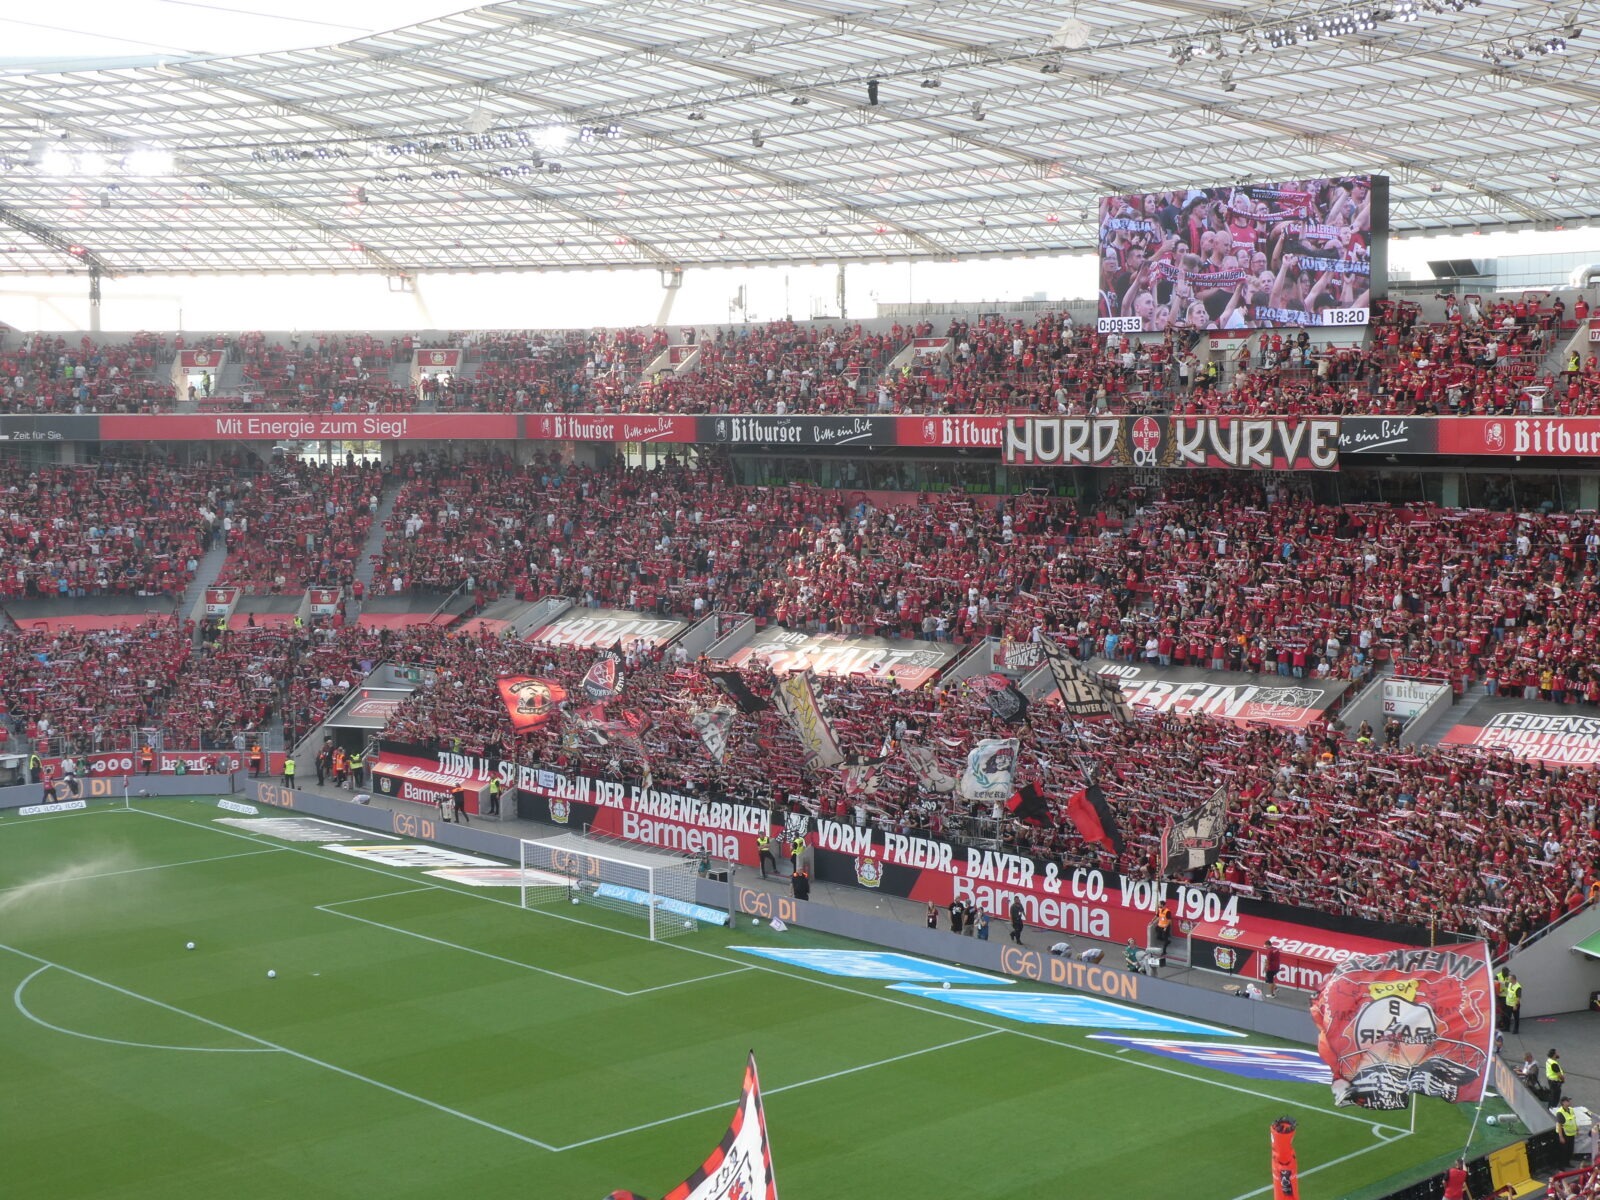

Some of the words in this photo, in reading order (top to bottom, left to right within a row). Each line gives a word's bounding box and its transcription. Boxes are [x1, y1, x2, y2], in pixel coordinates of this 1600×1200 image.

[1099, 319, 1141, 331] 0:09:53
[1329, 310, 1365, 323] 18:20
[13, 431, 30, 440] Zeit
[33, 431, 46, 440] für
[47, 431, 64, 440] Sie.
[216, 418, 243, 434] Mit
[248, 418, 315, 438] Energie
[320, 421, 357, 434] zum
[363, 418, 407, 438] Sieg!
[554, 416, 615, 439] Bitburger
[624, 424, 642, 440] Bitte
[644, 426, 658, 435] ein
[658, 417, 674, 431] Bit
[731, 417, 802, 442] Bitburger
[813, 425, 835, 443] Bitte
[837, 428, 853, 438] ein
[854, 418, 873, 434] Bit
[941, 418, 1002, 446] Bitbur
[1133, 430, 1159, 438] BAYER
[1355, 428, 1380, 443] ein
[1382, 420, 1409, 440] Bit
[1176, 419, 1340, 468] KURVE
[1133, 447, 1158, 467] 04
[772, 632, 809, 645] FÜR
[1097, 664, 1141, 679] UND
[1384, 702, 1395, 712] D2
[281, 789, 293, 808] DI
[421, 821, 435, 840] DI
[438, 751, 474, 779] TURN
[479, 757, 490, 782] U.
[595, 779, 625, 810] DER
[630, 785, 770, 836] FARBENFABRIKEN
[817, 818, 876, 858] VORM.
[882, 831, 958, 874] FRIEDR.
[966, 847, 1036, 889] BAYER
[1043, 862, 1062, 895] &
[1072, 867, 1108, 903] CO.
[1119, 874, 1168, 912] VON
[1175, 885, 1240, 928] 1904
[623, 811, 740, 861] Barmenia
[778, 898, 797, 922] DI
[953, 875, 1110, 938] Barmenia
[1051, 958, 1138, 1001] DITCON
